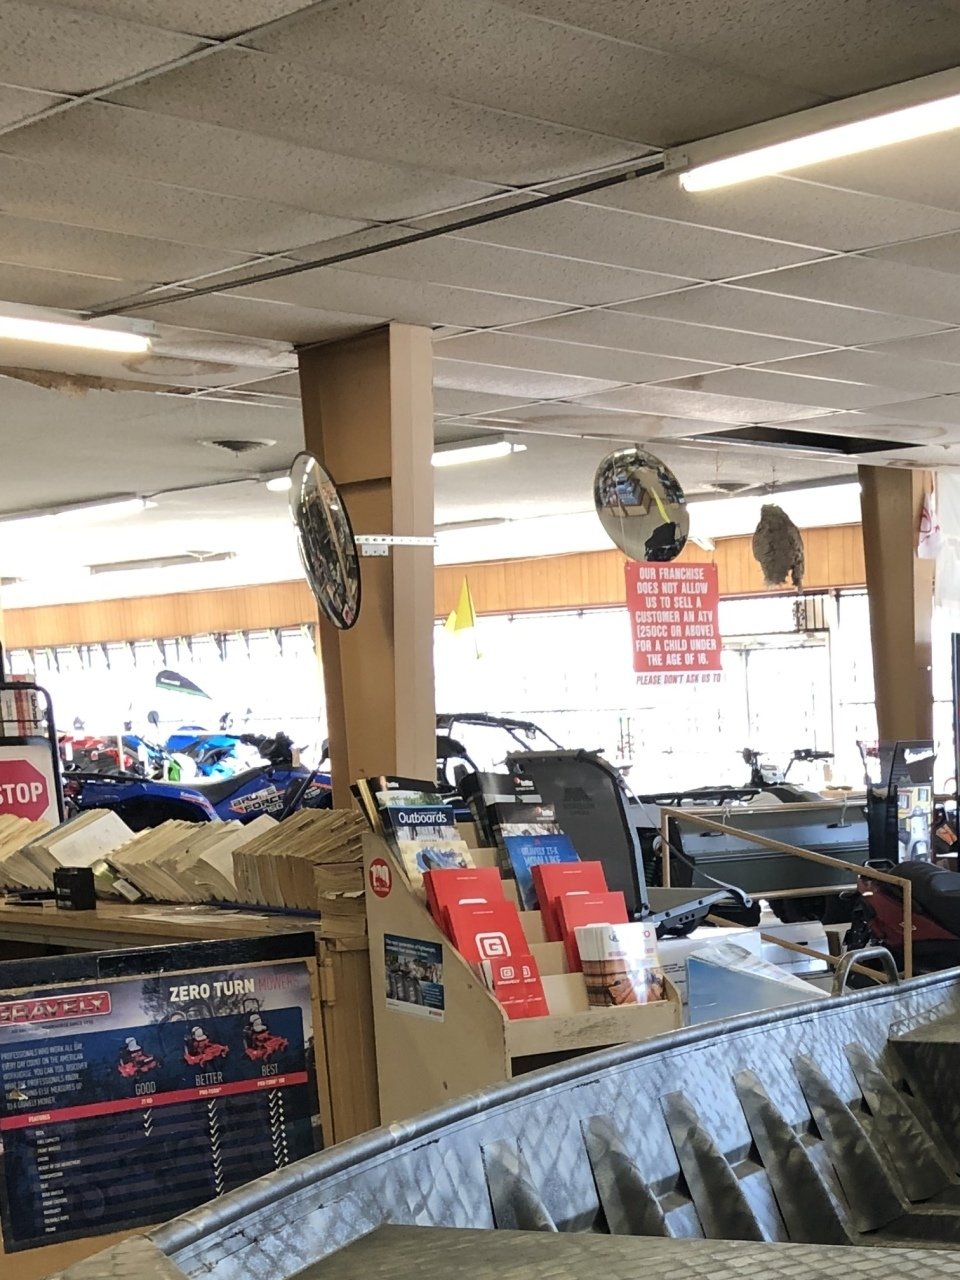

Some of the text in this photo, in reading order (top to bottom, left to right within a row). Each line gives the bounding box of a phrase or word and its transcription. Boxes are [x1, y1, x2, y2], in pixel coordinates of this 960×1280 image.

[639, 567, 704, 579] OUR FRANCHISE
[637, 582, 708, 594] DOES NOT ALLOW
[645, 596, 702, 608] US TO SELL A
[635, 610, 713, 623] CUSTOMER AN ATV
[670, 625, 682, 637] OR
[636, 639, 717, 652] FOR A CHILD UNDER
[647, 654, 663, 666] THE
[666, 654, 682, 665] AGE
[685, 653, 695, 664] OF
[0, 782, 43, 805] TOP
[398, 810, 447, 824] Outboards
[169, 984, 210, 1002] ZERO
[213, 979, 255, 997] TURN
[261, 1063, 279, 1077] BEST
[195, 1071, 223, 1087] BETTER
[135, 1081, 156, 1096] GOOD
